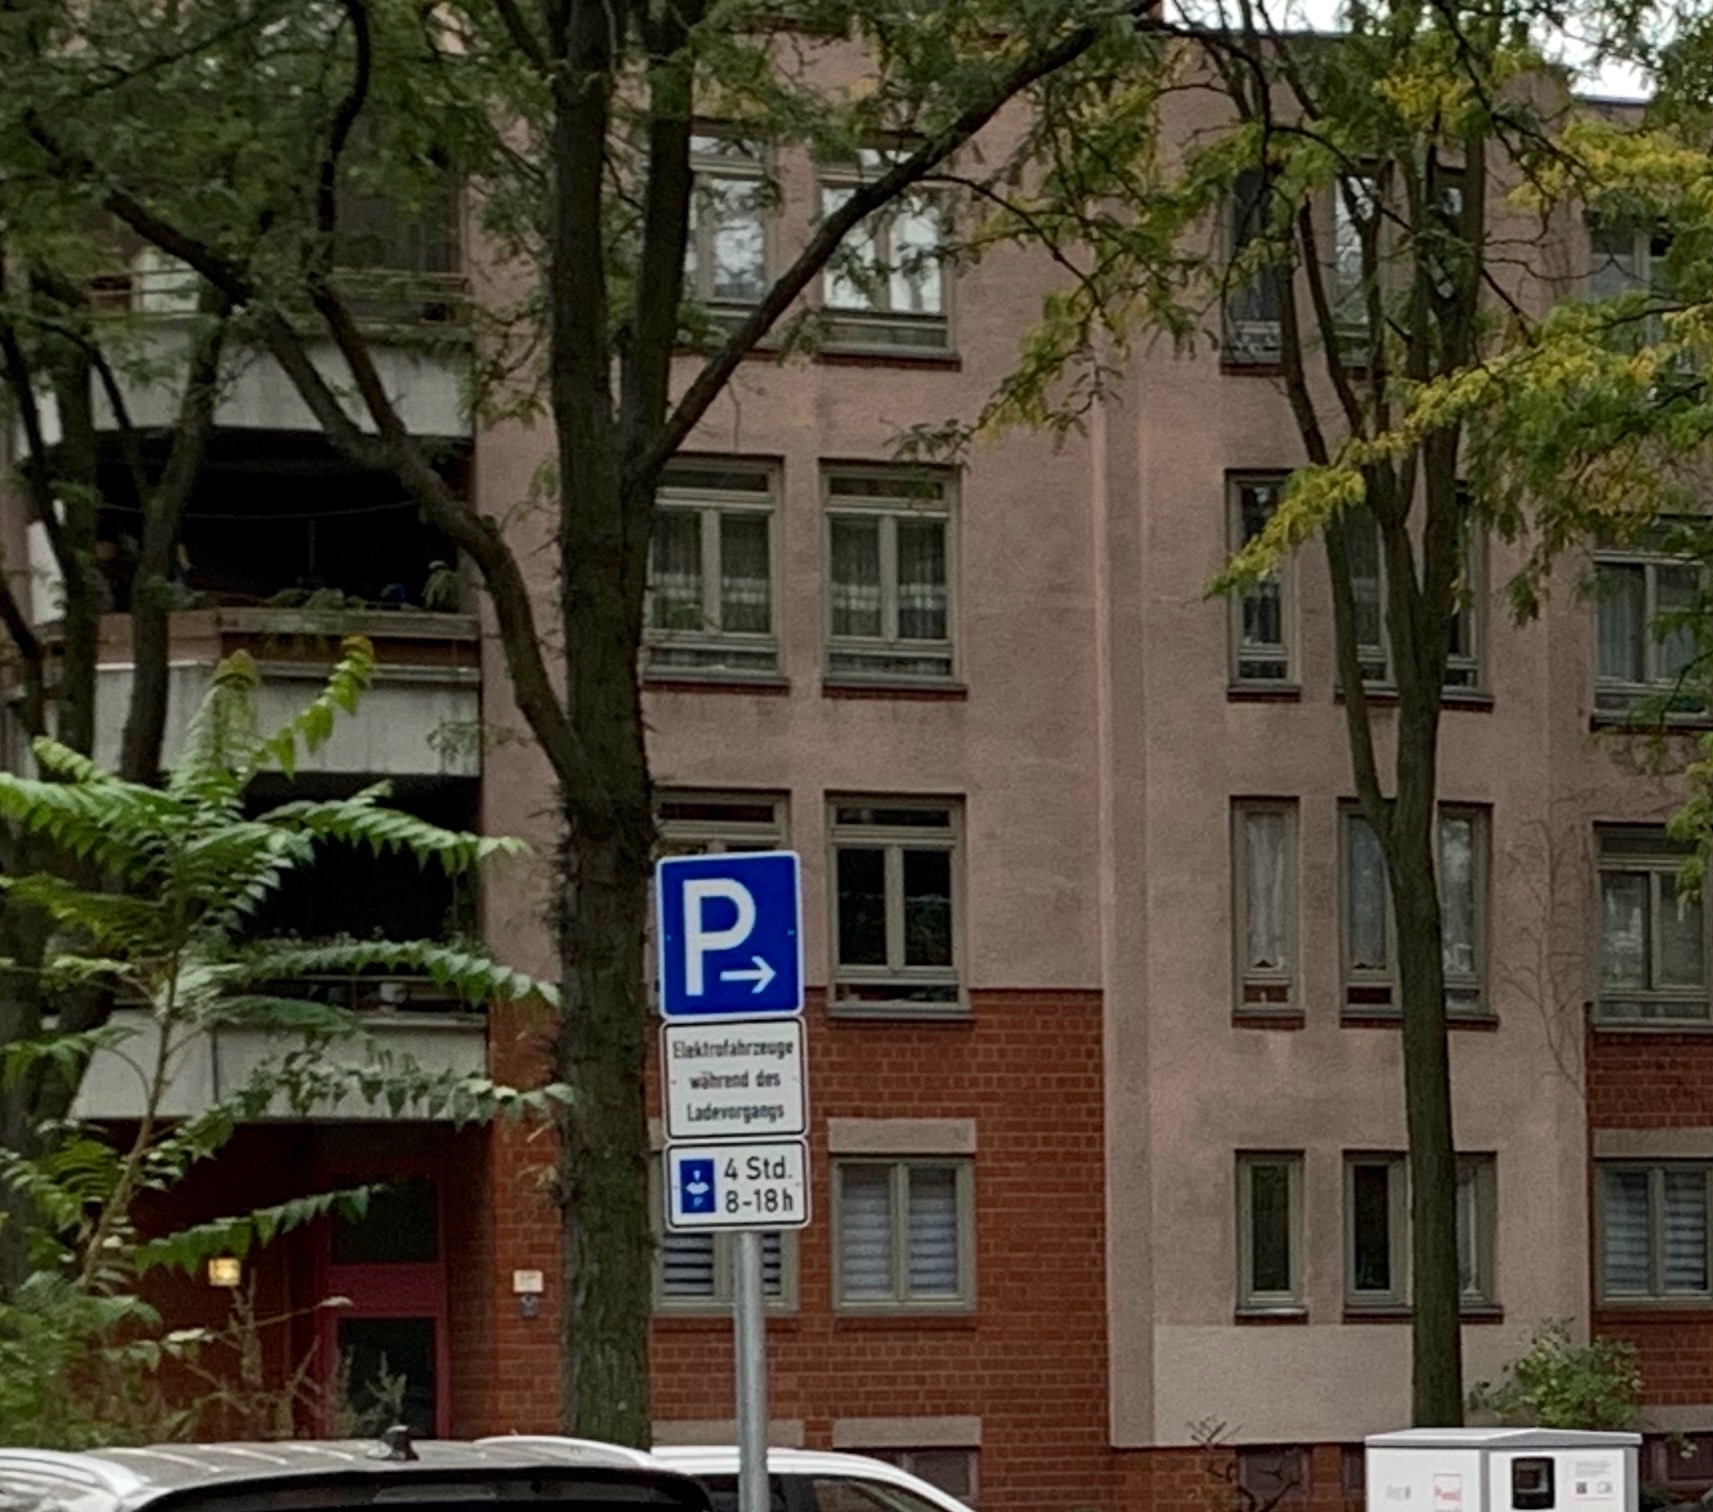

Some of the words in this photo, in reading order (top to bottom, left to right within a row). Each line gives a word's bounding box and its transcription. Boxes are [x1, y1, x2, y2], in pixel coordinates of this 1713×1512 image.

[683, 878, 757, 997] P
[672, 1039, 794, 1060] Elektrofahrzeuge
[689, 1069, 749, 1090] während
[755, 1069, 781, 1088] des
[686, 1103, 785, 1123] Ladevorgangs
[724, 1158, 739, 1180] 4
[746, 1156, 793, 1180] Std.
